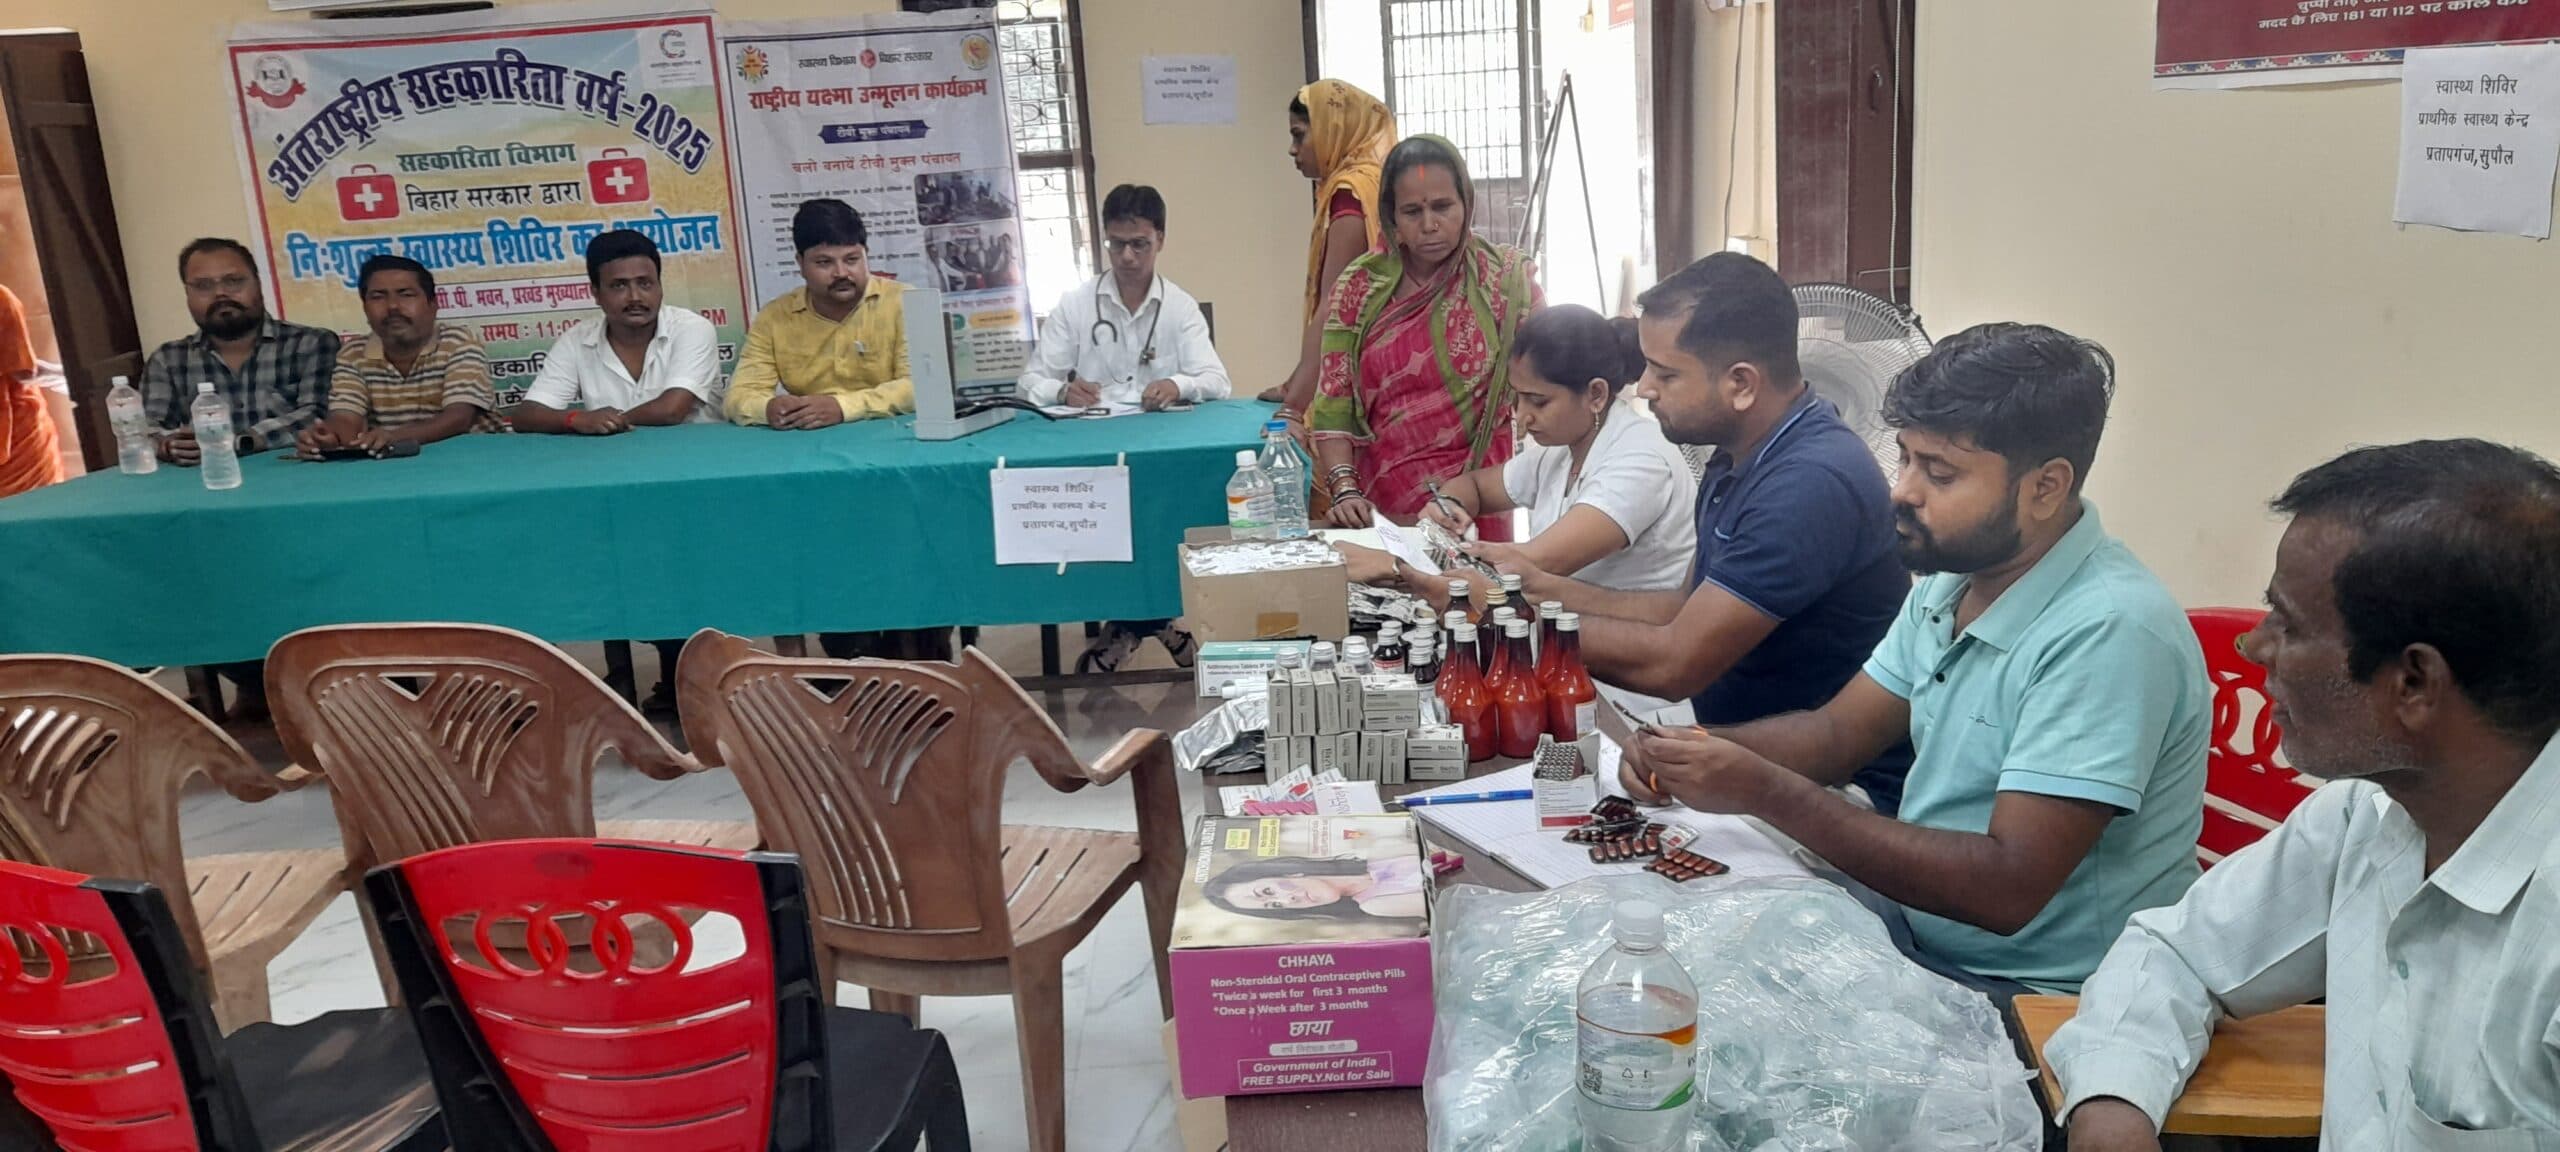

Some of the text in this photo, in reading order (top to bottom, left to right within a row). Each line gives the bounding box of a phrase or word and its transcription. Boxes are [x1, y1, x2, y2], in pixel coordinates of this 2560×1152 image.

[2258, 17, 2289, 29] मदद
[2291, 14, 2306, 26] के
[2310, 11, 2340, 24] लिए
[2343, 10, 2365, 21] 181
[2369, 7, 2388, 18] या
[2392, 5, 2415, 16] 112
[748, 76, 987, 112] राष्ट्रीय यक्ष्मा उन्मूलन कार्यक्रम
[2435, 74, 2518, 94] स्वास्थ्य शिविर
[398, 48, 568, 109] सहकारिता
[574, 70, 711, 170] वर्ष-2025
[2418, 108, 2530, 128] प्राथमिक स्वास्थ्य केन्द्र
[396, 142, 577, 172] सहकारिता विभाग
[792, 158, 817, 174] चलो
[889, 155, 916, 172] मुक्त
[920, 152, 962, 166] पंचायत
[2426, 144, 2514, 170] प्रतापगंज,सुपौल
[405, 182, 581, 211] बिहार सरकार द्वारा
[398, 232, 486, 268] स्वास्थ्य
[487, 218, 564, 264] शिविर
[480, 323, 519, 341] समय
[1065, 482, 1094, 493] शिविर
[1278, 954, 1336, 969] CHHAYA
[1211, 968, 1406, 988] Non-Steroidal Oral Contraceptive Pills
[1249, 992, 1256, 1000] a
[1258, 989, 1287, 999] week
[1289, 988, 1305, 998] for
[1313, 986, 1333, 997] first
[1336, 986, 1343, 996] 3
[1347, 983, 1388, 995] months
[1248, 1007, 1255, 1015] a
[1257, 1004, 1287, 1014] Week
[1290, 1002, 1314, 1013] after
[1320, 1002, 1327, 1011] 3
[1329, 1000, 1369, 1011] months
[1289, 1019, 1334, 1037] छाया
[1253, 1056, 1377, 1073] Government of India
[1242, 1074, 1274, 1086] FREE
[1347, 1070, 1363, 1081] for
[1366, 1069, 1391, 1080] Sale
